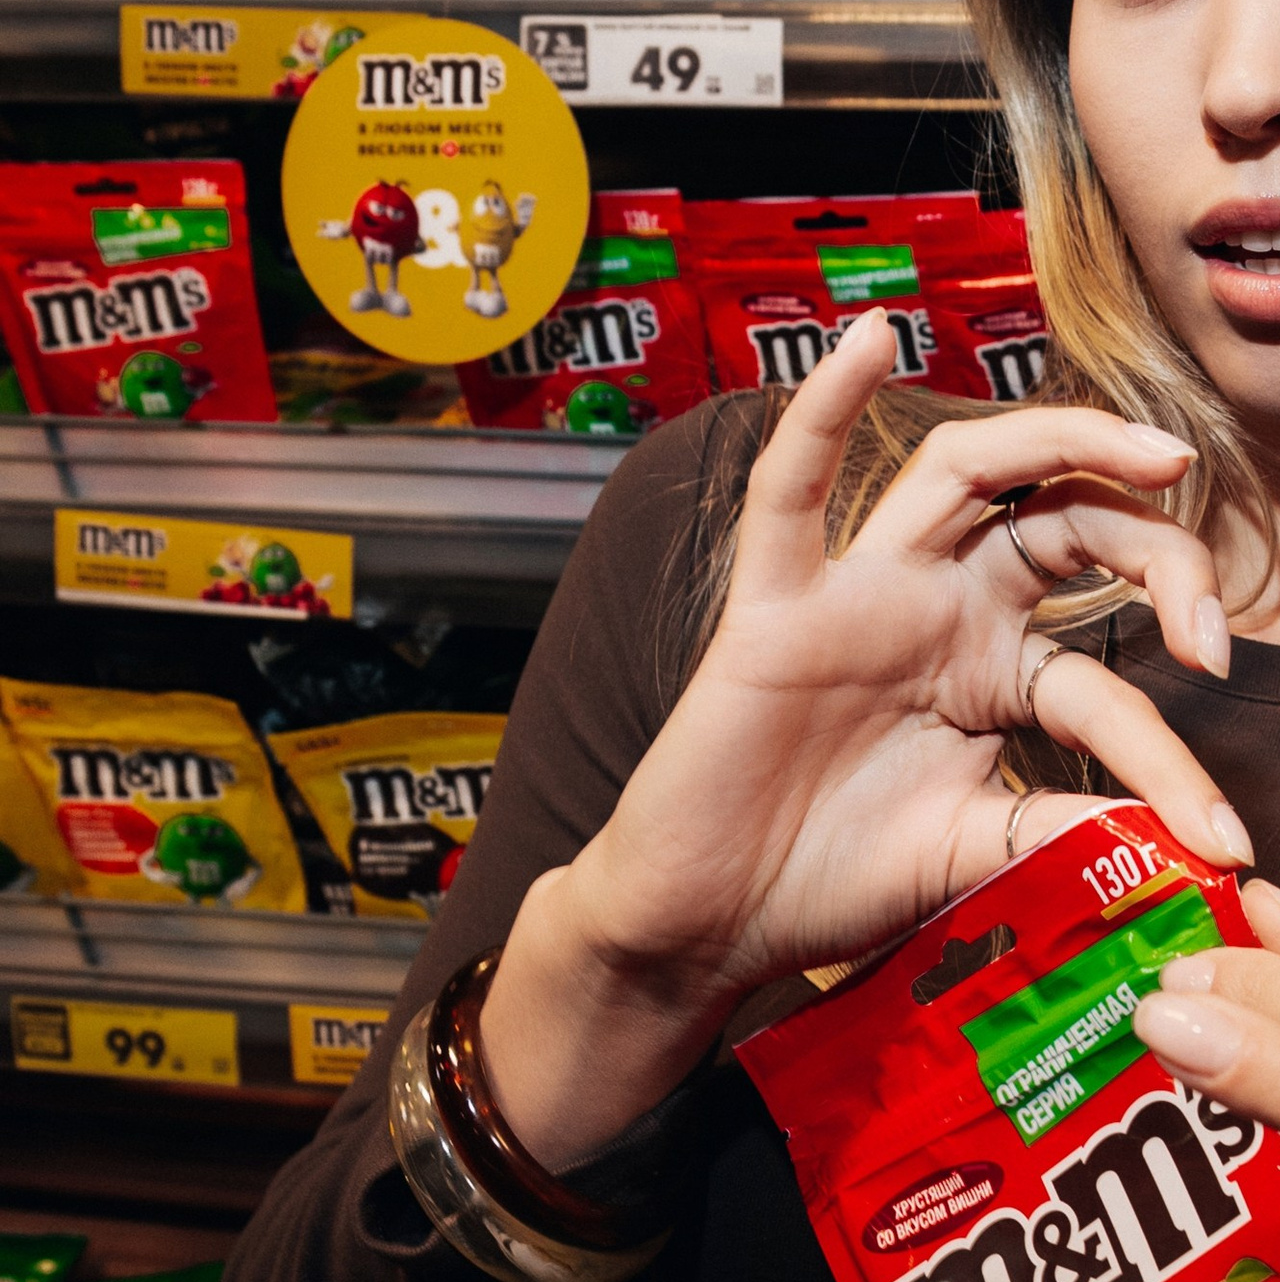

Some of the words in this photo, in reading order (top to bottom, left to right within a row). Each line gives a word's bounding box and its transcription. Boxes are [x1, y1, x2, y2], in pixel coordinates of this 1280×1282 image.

[631, 45, 701, 92] 49
[105, 1027, 166, 1069] 99
[996, 981, 1143, 1108] ОГРАНИЧЕННАЯ
[1016, 1072, 1086, 1136] СЕРИЯ
[875, 1228, 896, 1250] СО
[895, 1202, 949, 1241] ВКУСОМ
[947, 1179, 994, 1216] ВИШНИ
[892, 1170, 966, 1221] ХРУСТЯЩИЙ
